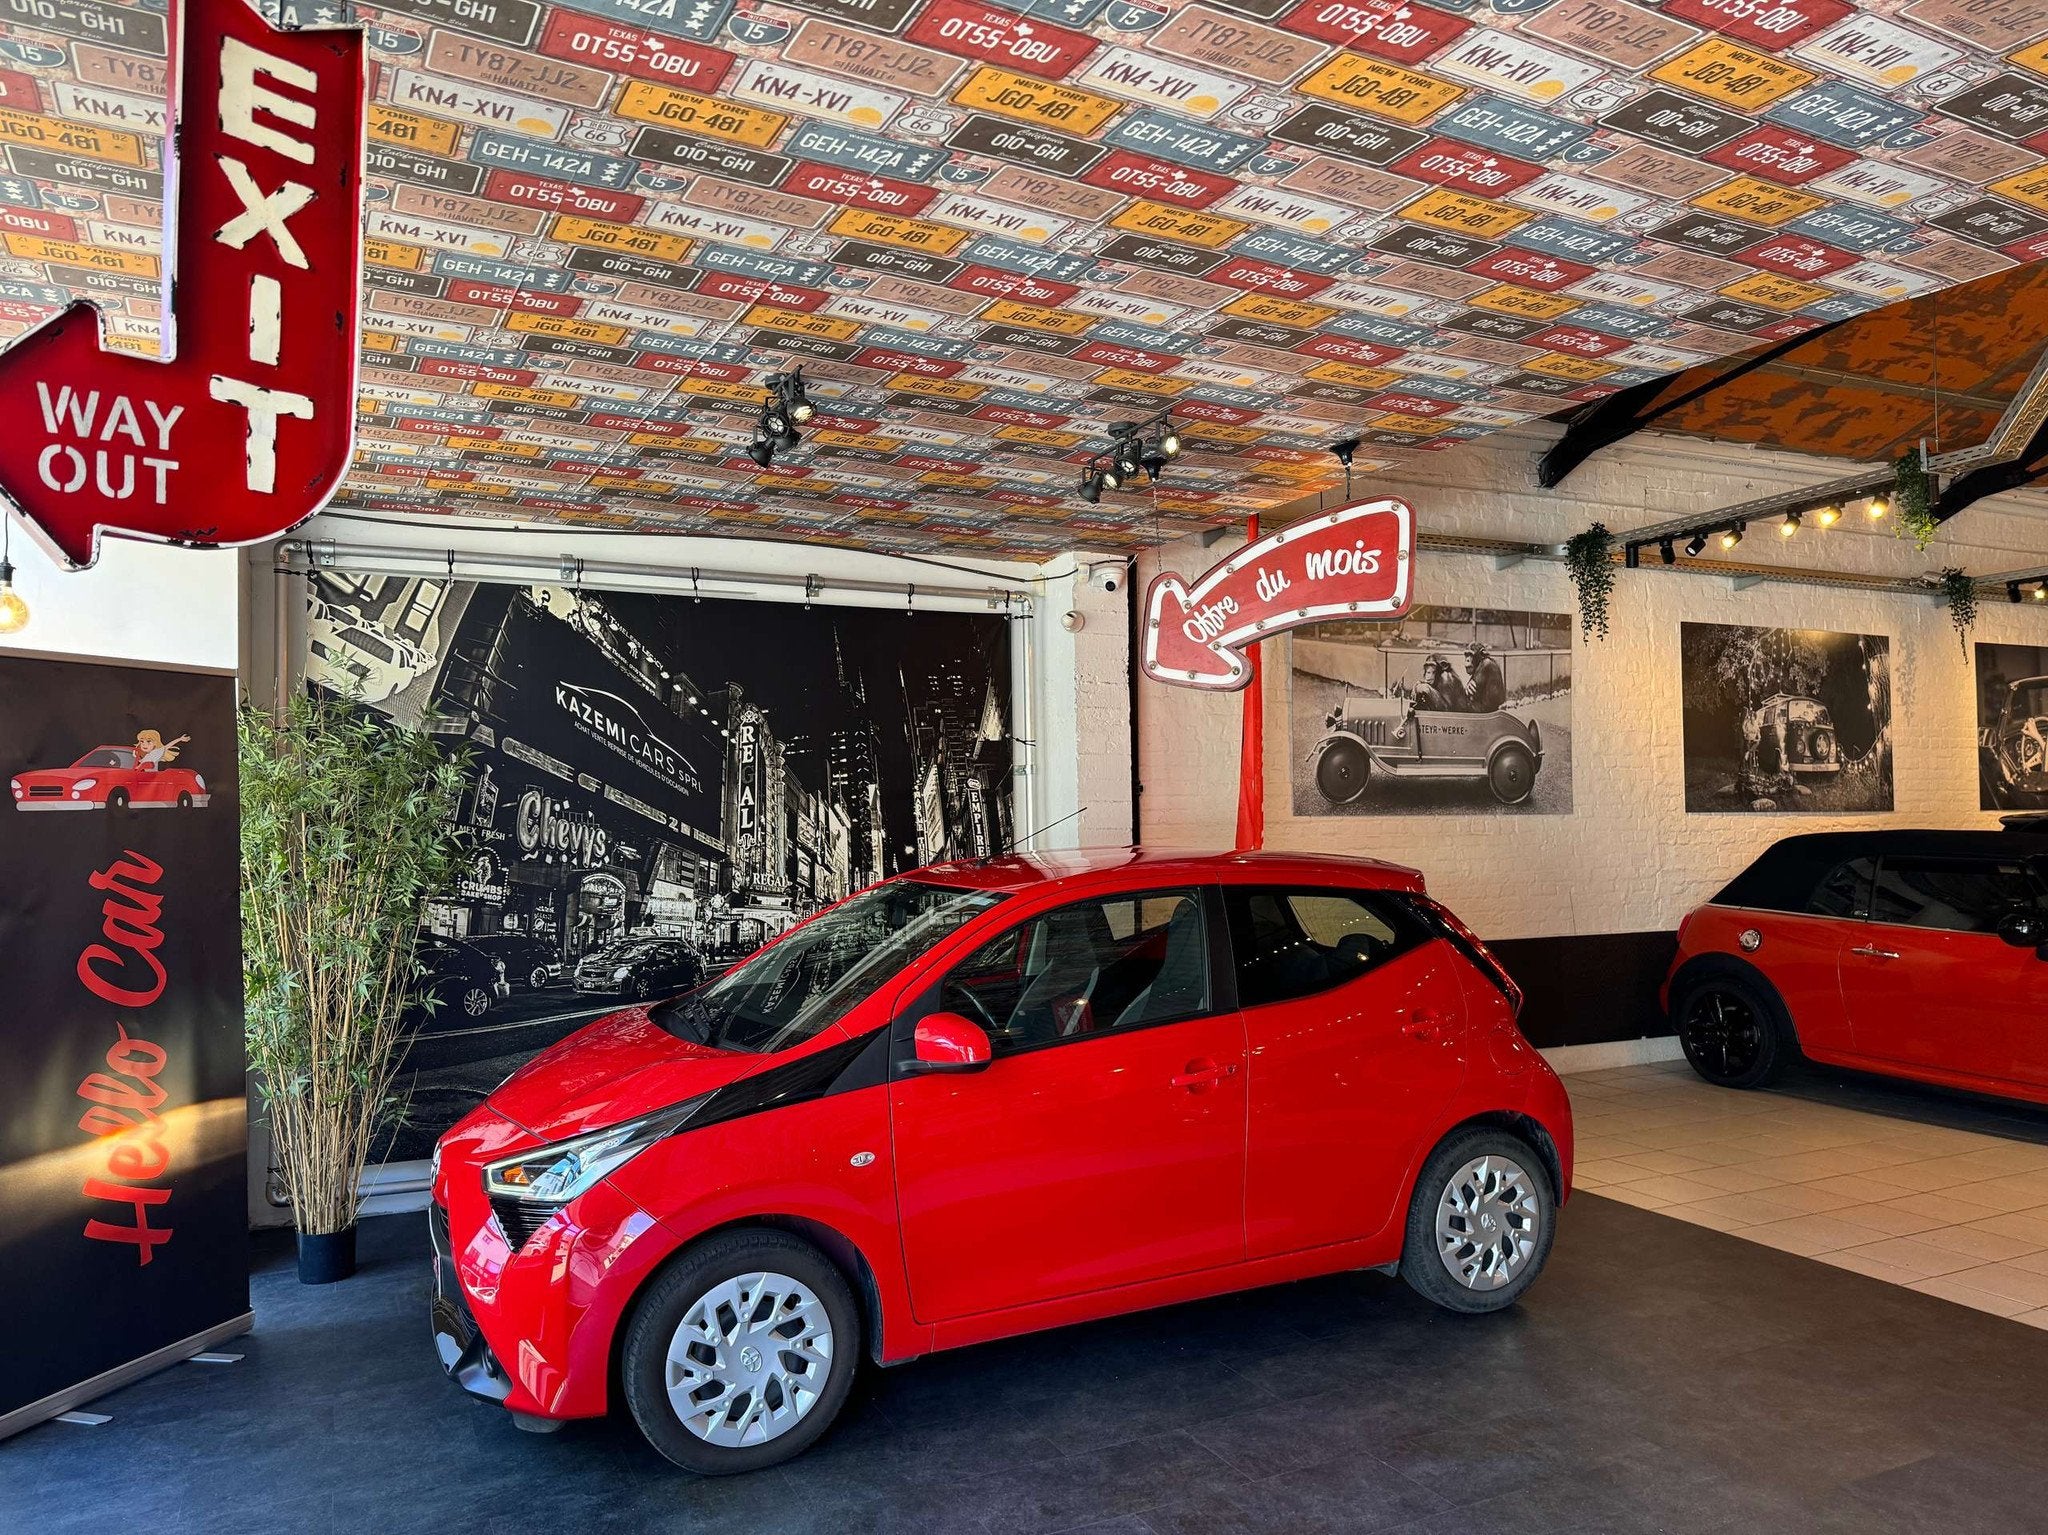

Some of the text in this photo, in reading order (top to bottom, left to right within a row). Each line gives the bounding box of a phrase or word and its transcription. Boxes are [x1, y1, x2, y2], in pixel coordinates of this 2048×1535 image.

[1119, 7, 1147, 25] 15
[1366, 0, 1394, 11] TEXAS
[745, 22, 769, 39] 15
[983, 13, 1012, 26] TEXAS
[375, 31, 398, 48] 15
[609, 28, 638, 41] TEXAS
[16, 42, 43, 62] 15
[1725, 51, 1790, 76] NEW YORK
[842, 63, 887, 79] HAWAII
[1364, 66, 1435, 89] NEW YORK
[1925, 77, 1959, 90] 66
[641, 86, 656, 95] 21
[1012, 79, 1090, 102] NEW YORK
[668, 93, 752, 115] NEW YORK
[1240, 107, 1269, 119] 66
[1783, 93, 1881, 132] GEH-142A
[50, 121, 97, 135] YORK
[584, 130, 609, 141] 66
[1447, 107, 1548, 145] GEH-142A
[795, 132, 903, 168] GEH-142A
[1117, 121, 1222, 157] GEH-142A
[480, 141, 590, 176] GEH-142A
[59, 195, 80, 206] 15
[1517, 225, 1602, 251] GEH-142A
[1799, 212, 1882, 240] GEH-142A
[970, 245, 1058, 270] GEH-142A
[1241, 236, 1327, 262] GEH-142A
[210, 35, 317, 494] EXIT
[441, 259, 534, 283] GEH-142A
[703, 251, 794, 276] GEH-142A
[35, 381, 185, 450] WAY
[37, 441, 180, 505] OUT
[1182, 595, 1239, 643] Offre
[1256, 567, 1292, 602] du
[555, 686, 704, 793] KAZEMI CARS SPRL
[740, 725, 755, 829] REGAL
[517, 791, 607, 868] Chevys
[970, 791, 986, 857] EMPIRE
[461, 880, 503, 895] CRUMBS
[76, 849, 174, 1268] Hello Car
